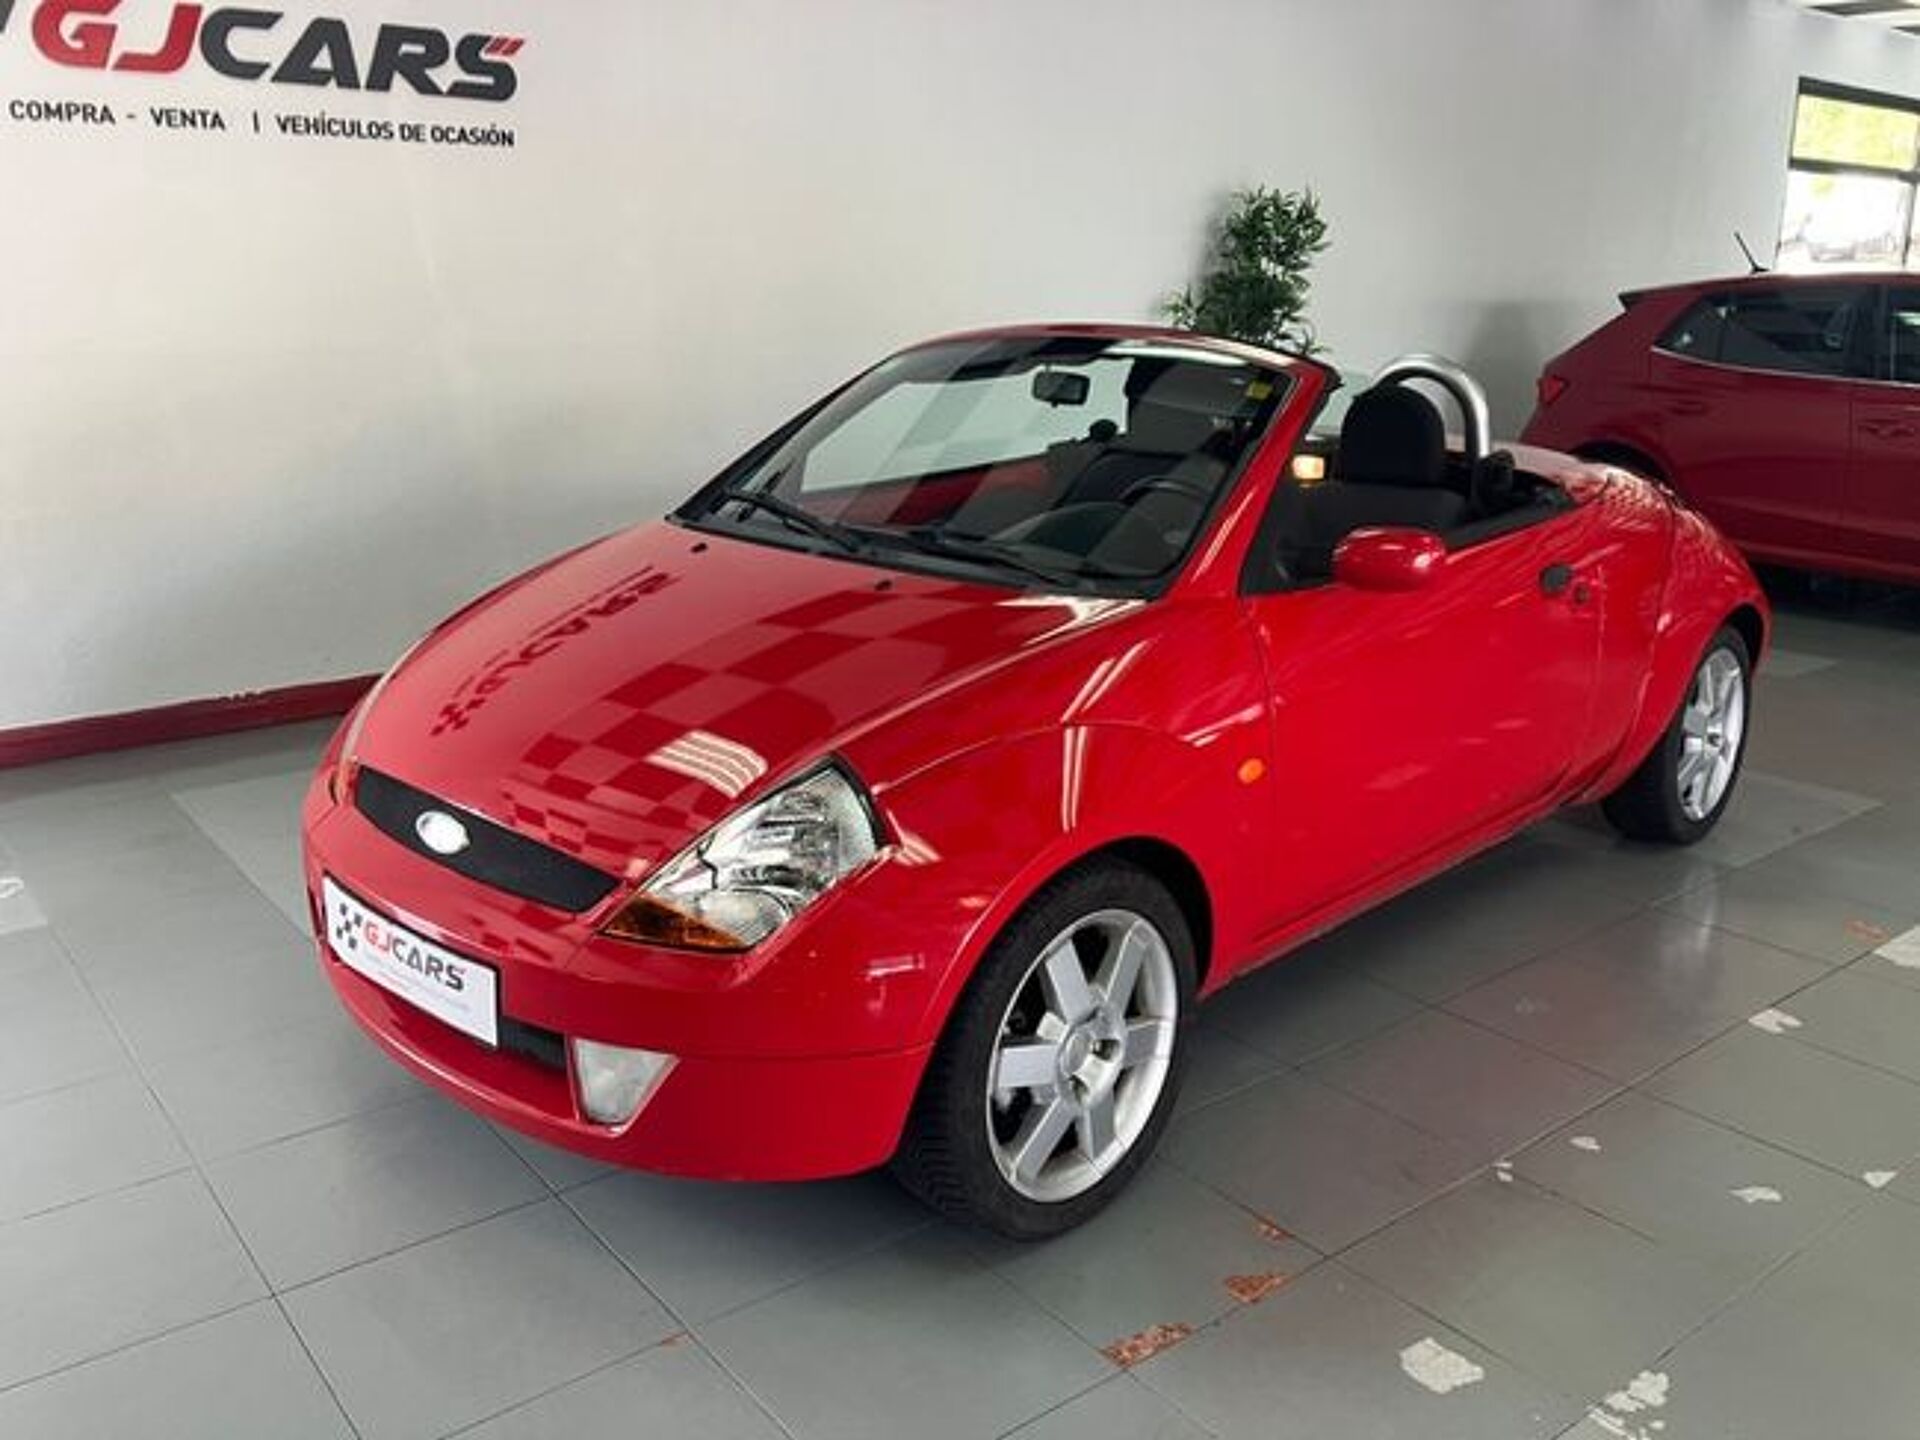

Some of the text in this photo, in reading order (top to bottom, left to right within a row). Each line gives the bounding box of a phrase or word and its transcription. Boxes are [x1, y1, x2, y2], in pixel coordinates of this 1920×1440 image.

[32, 0, 524, 101] GJCARS
[9, 100, 116, 124] COMPRA
[150, 107, 226, 131] VENTA
[275, 111, 394, 140] VEHÍCULOS
[400, 123, 427, 142] DE
[430, 124, 514, 147] OCASIÓN
[365, 921, 467, 992] GJCARS
